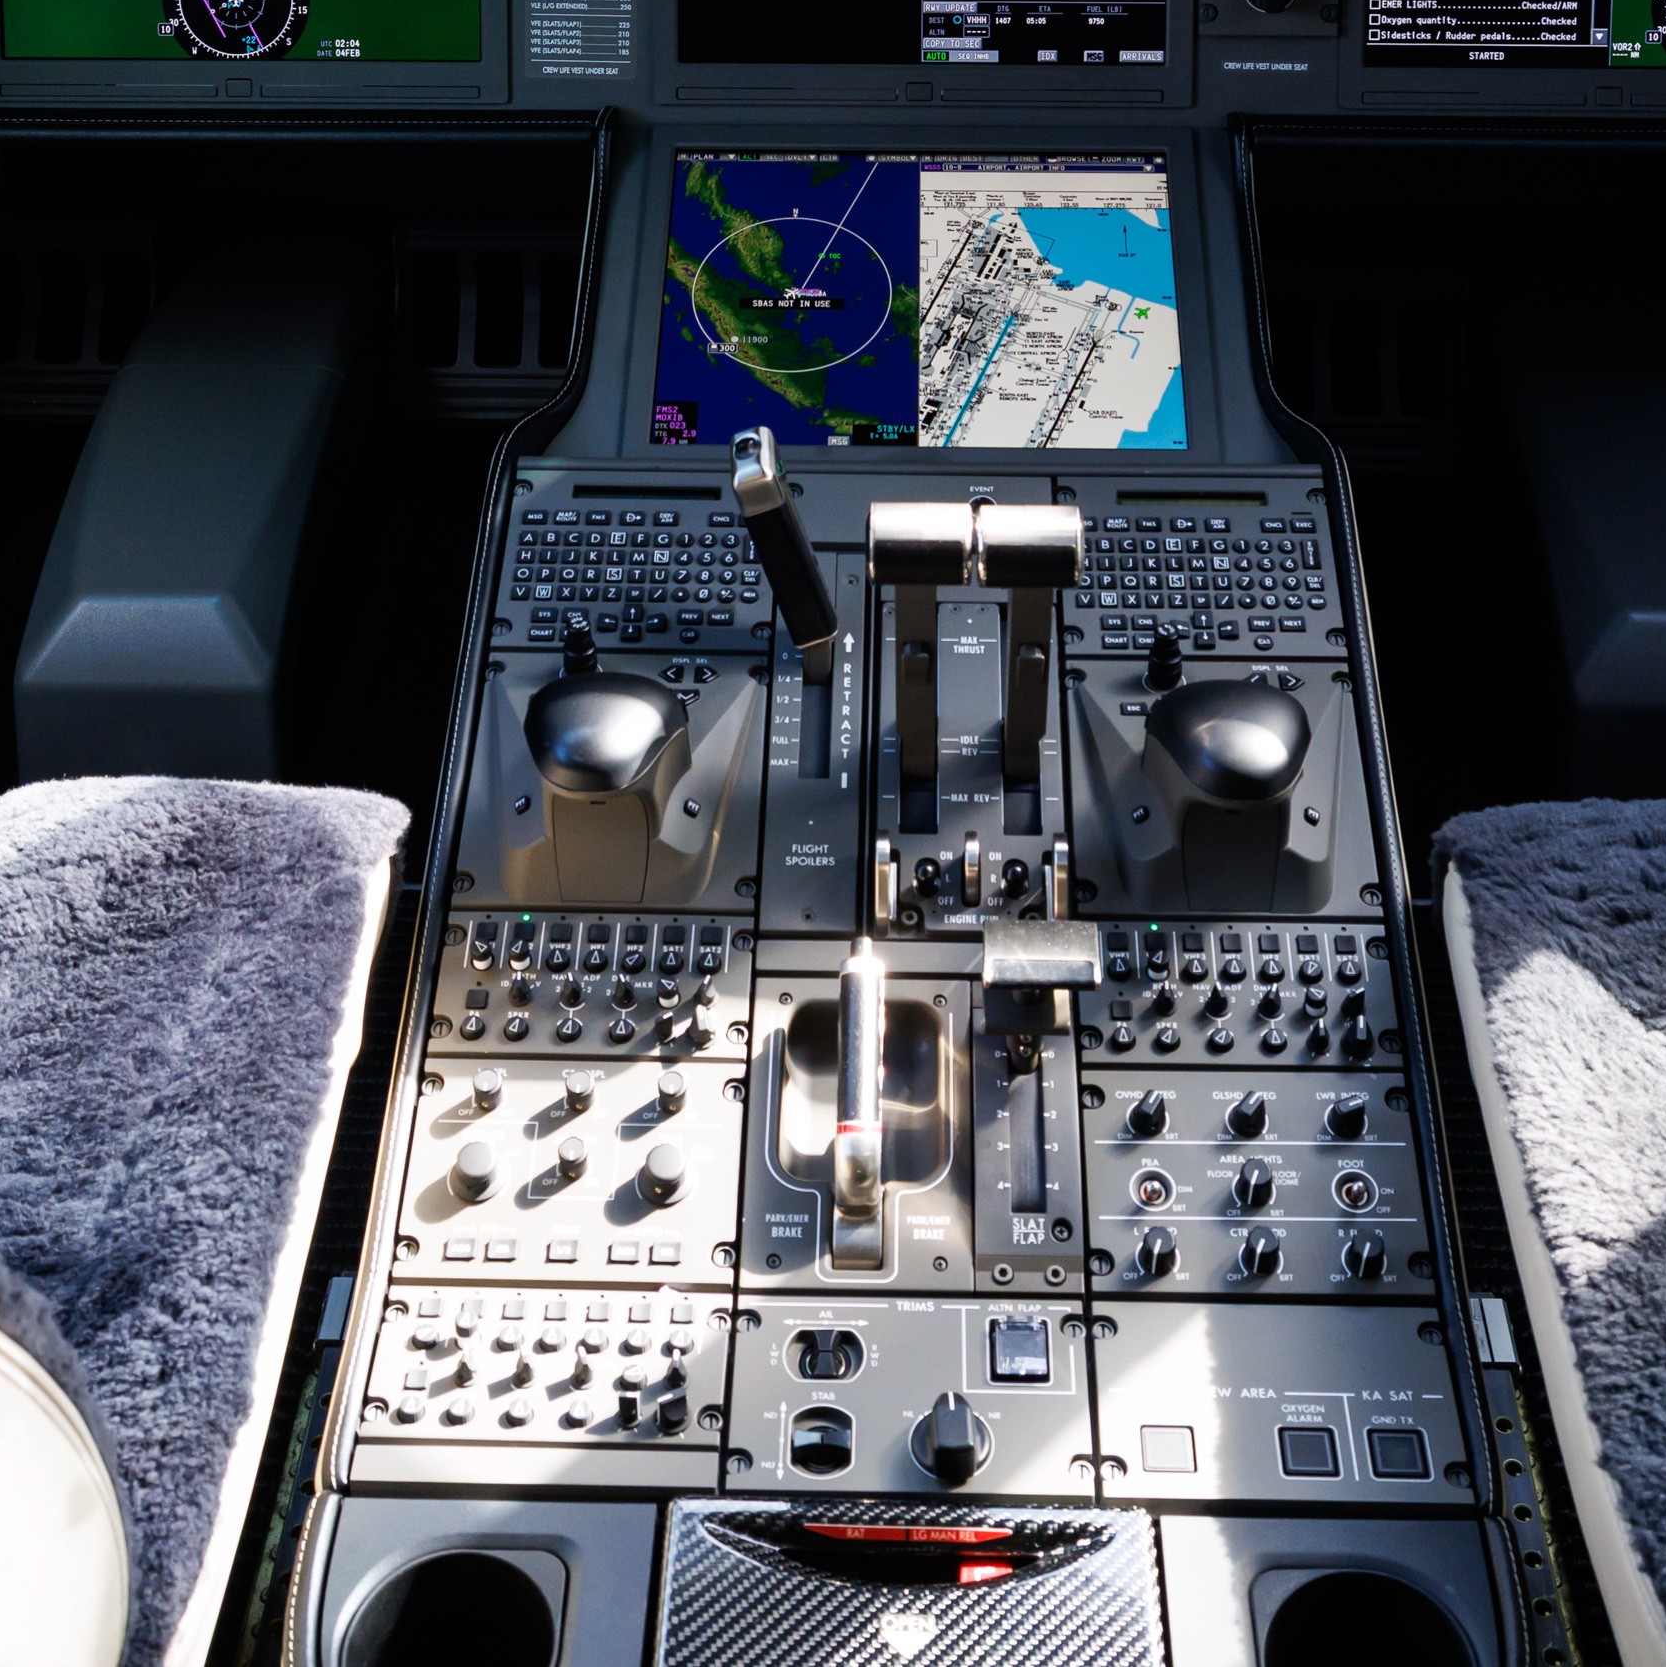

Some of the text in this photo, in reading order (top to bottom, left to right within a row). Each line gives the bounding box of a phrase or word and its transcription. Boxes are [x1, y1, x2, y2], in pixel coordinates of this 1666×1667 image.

[925, 3, 975, 12] RWY UPDATE
[335, 39, 360, 49] 02:04
[335, 48, 361, 58] 04FEB
[1121, 52, 1162, 61] ARRIVALS
[1469, 51, 1505, 61] STARTED
[542, 66, 558, 74] CREW
[559, 66, 571, 74] LIFE
[585, 67, 605, 75] UNDER
[605, 67, 619, 75] SEAT
[1014, 163, 1044, 172] AIRPORT
[1048, 163, 1065, 172] INFO
[752, 299, 831, 308] SBAS NOT IN USE
[742, 335, 769, 344] 11900
[719, 344, 736, 353] 300
[876, 424, 915, 434] STBY/LX
[969, 485, 994, 493] EVENT
[960, 636, 978, 645] MAX
[953, 644, 985, 654] THRUST
[777, 675, 791, 683] 1/4
[840, 662, 852, 759] RETRACT
[772, 735, 789, 745] FULL
[960, 735, 979, 745] IDLE
[769, 758, 790, 766] MAX
[950, 793, 990, 803] MAX REV
[791, 843, 829, 854] FLIGHT
[785, 856, 836, 866] SPOILERS
[944, 914, 977, 925] ENGINE
[1315, 1091, 1336, 1101] LWR
[1141, 1158, 1160, 1168] PBA
[1337, 1159, 1364, 1169] FOOT
[765, 1213, 810, 1224] PARK/EMER
[1012, 1217, 1046, 1231] SLAT
[771, 1226, 803, 1238] BRAKE
[913, 1228, 946, 1241] BRAKE
[1012, 1232, 1045, 1245] FLAP
[895, 1300, 935, 1312] TRIMS
[811, 1391, 836, 1401] STAB
[1240, 1387, 1277, 1399] AREA
[1361, 1390, 1413, 1402] KA SAT
[1280, 1403, 1325, 1415] OXYGEN
[1286, 1414, 1323, 1423] ALARM
[846, 1527, 866, 1538] RAT
[913, 1529, 977, 1542] LG MAN REL
[882, 1614, 935, 1634] OPEN
